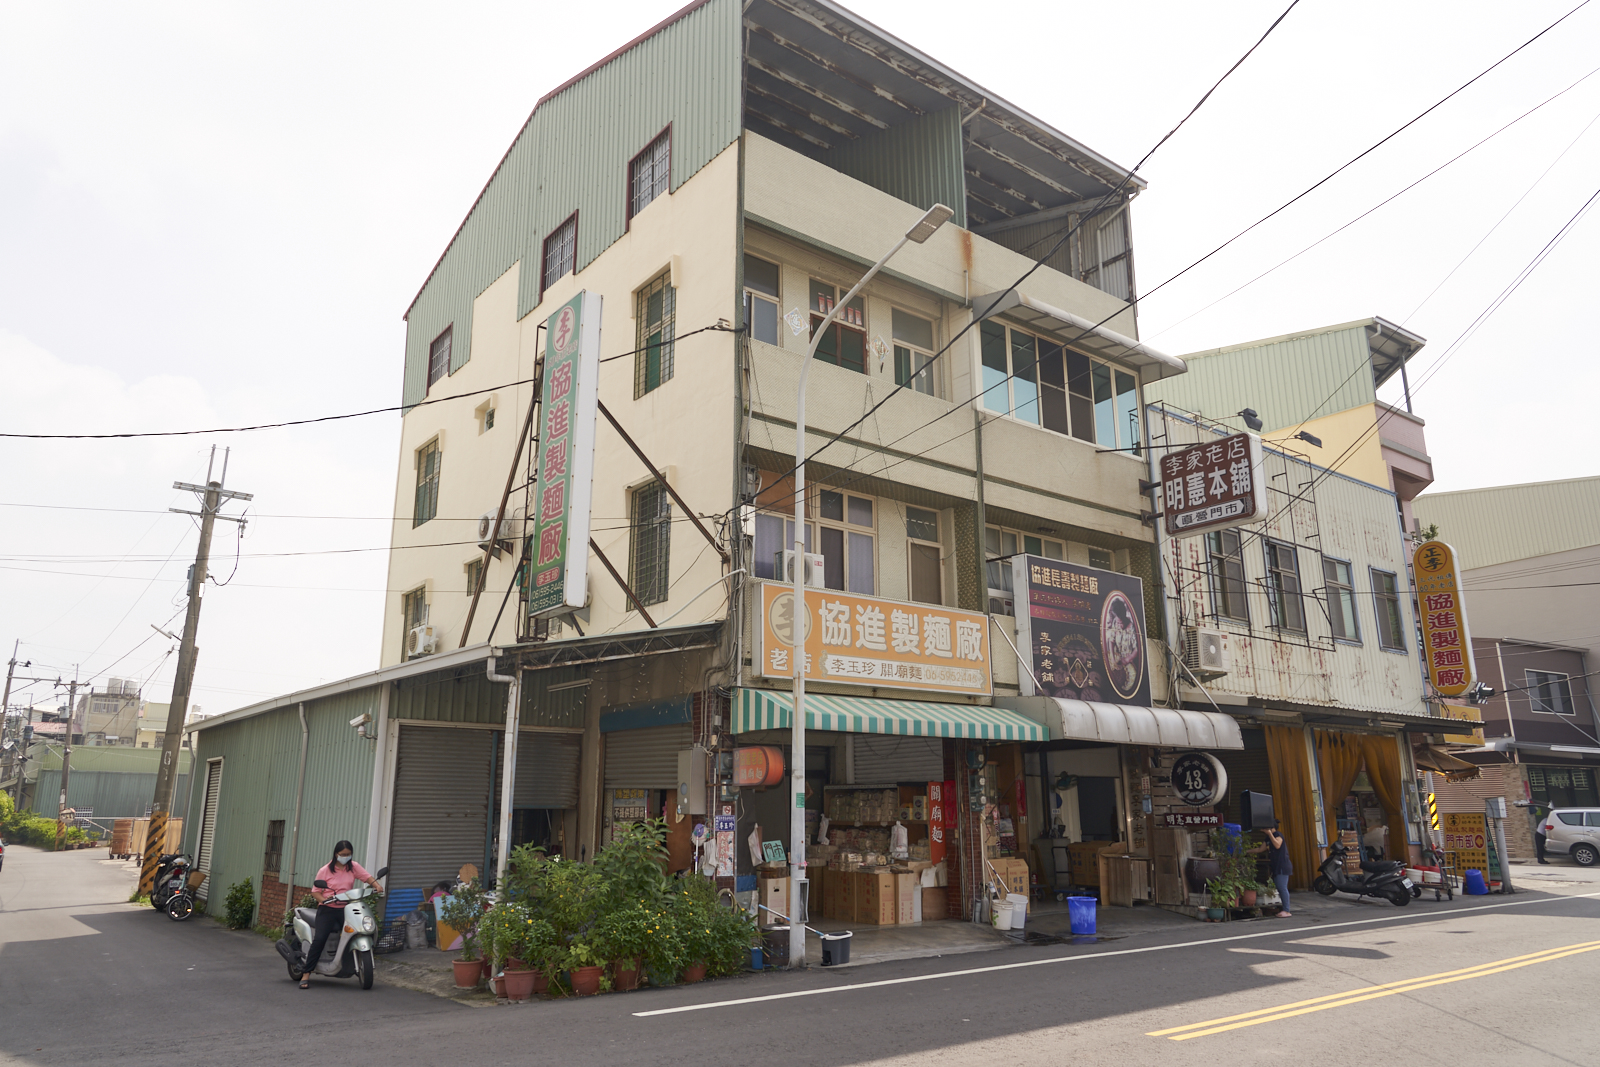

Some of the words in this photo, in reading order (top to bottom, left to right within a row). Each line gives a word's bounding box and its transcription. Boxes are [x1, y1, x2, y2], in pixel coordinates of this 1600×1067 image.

[556, 310, 571, 349] 李
[537, 360, 572, 567] 協進製麵廠
[1166, 437, 1245, 476] 李家老店
[1181, 503, 1238, 525] 直營門市
[1420, 581, 1454, 592] 60年老店
[818, 599, 984, 662] 協進製麵廠
[1424, 593, 1466, 687] 協進製麵廠
[831, 658, 876, 675] 李玉珍
[1184, 769, 1203, 790] 43
[764, 843, 783, 858] 門市
[1446, 834, 1475, 848] 門市部
